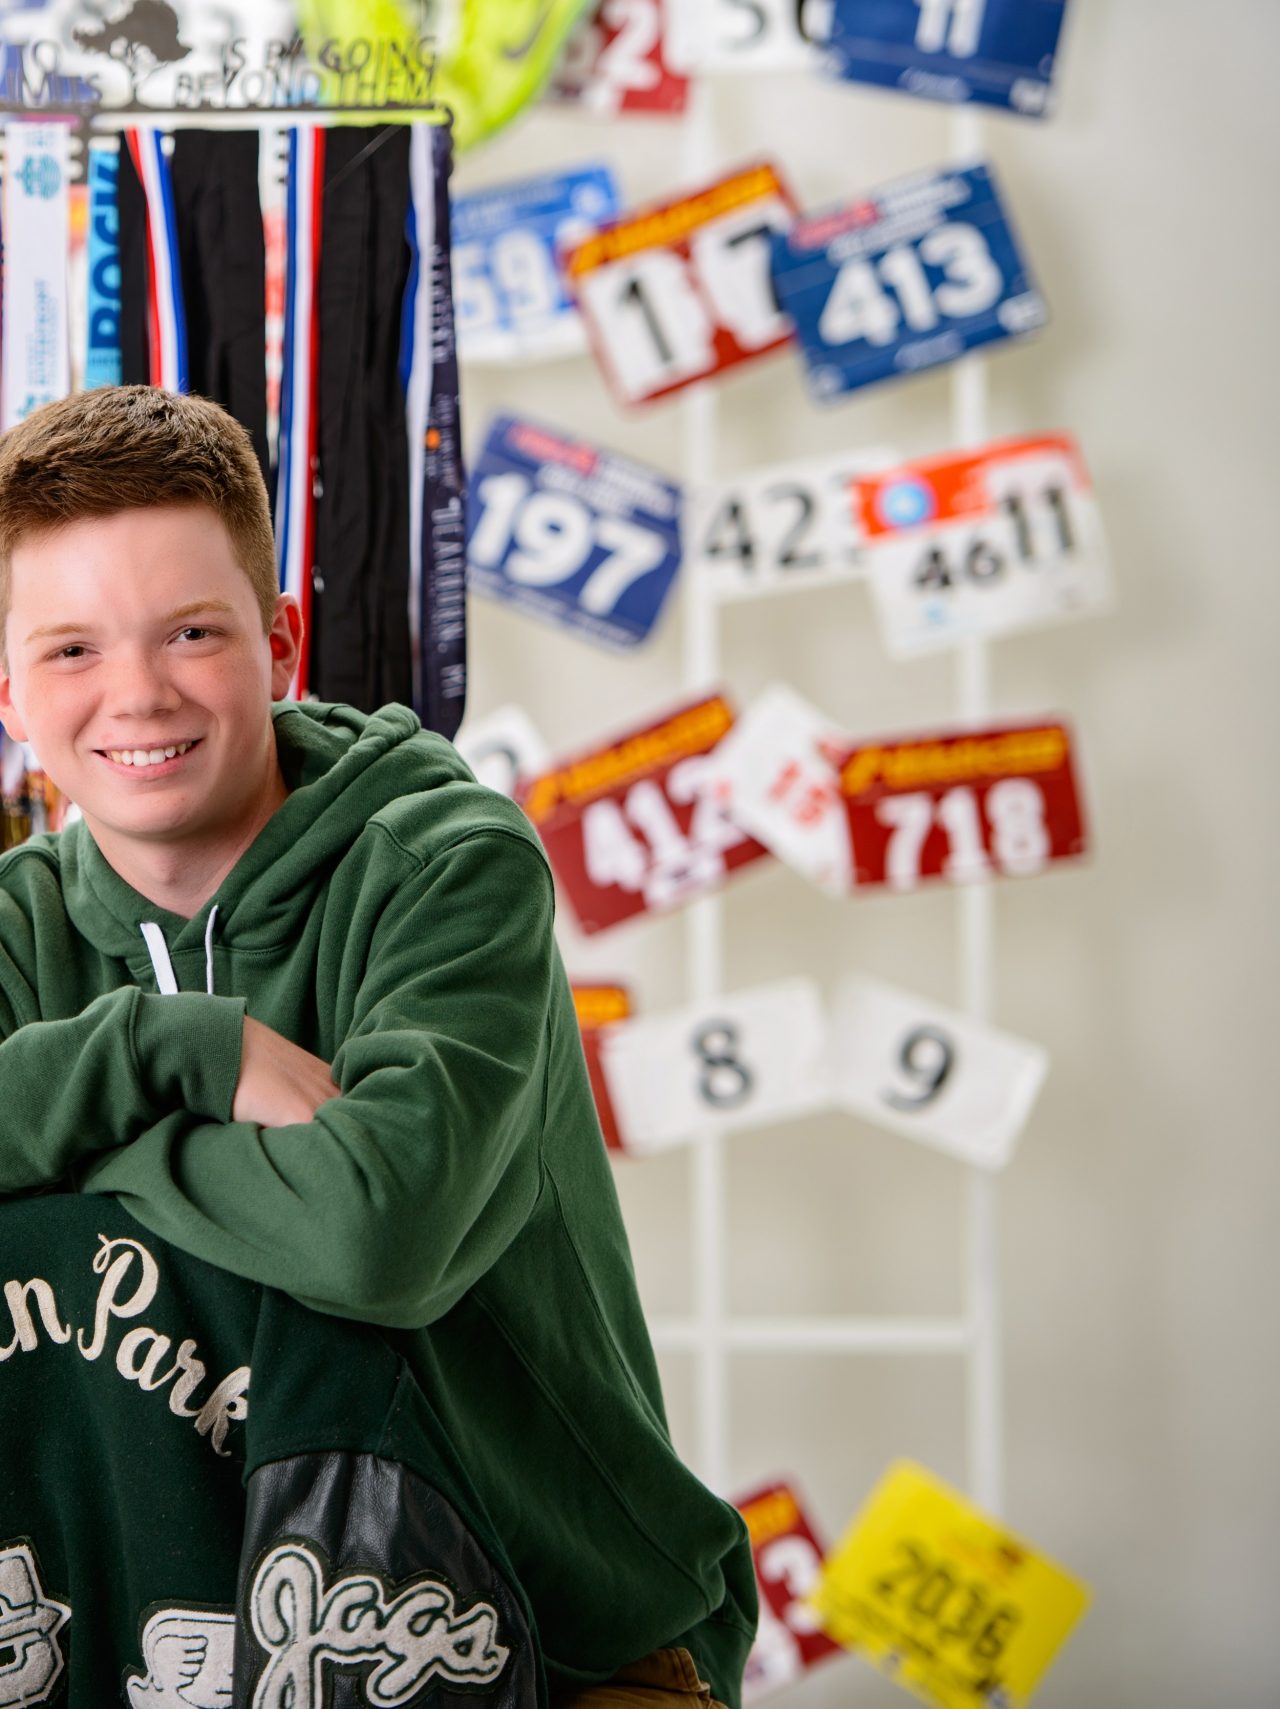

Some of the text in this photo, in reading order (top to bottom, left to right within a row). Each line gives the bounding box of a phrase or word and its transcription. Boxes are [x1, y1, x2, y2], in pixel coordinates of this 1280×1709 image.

[818, 222, 1004, 346] 413
[466, 470, 668, 619] 197
[873, 778, 1050, 890] 718
[690, 1018, 753, 1110] 8
[884, 1024, 955, 1113] 9
